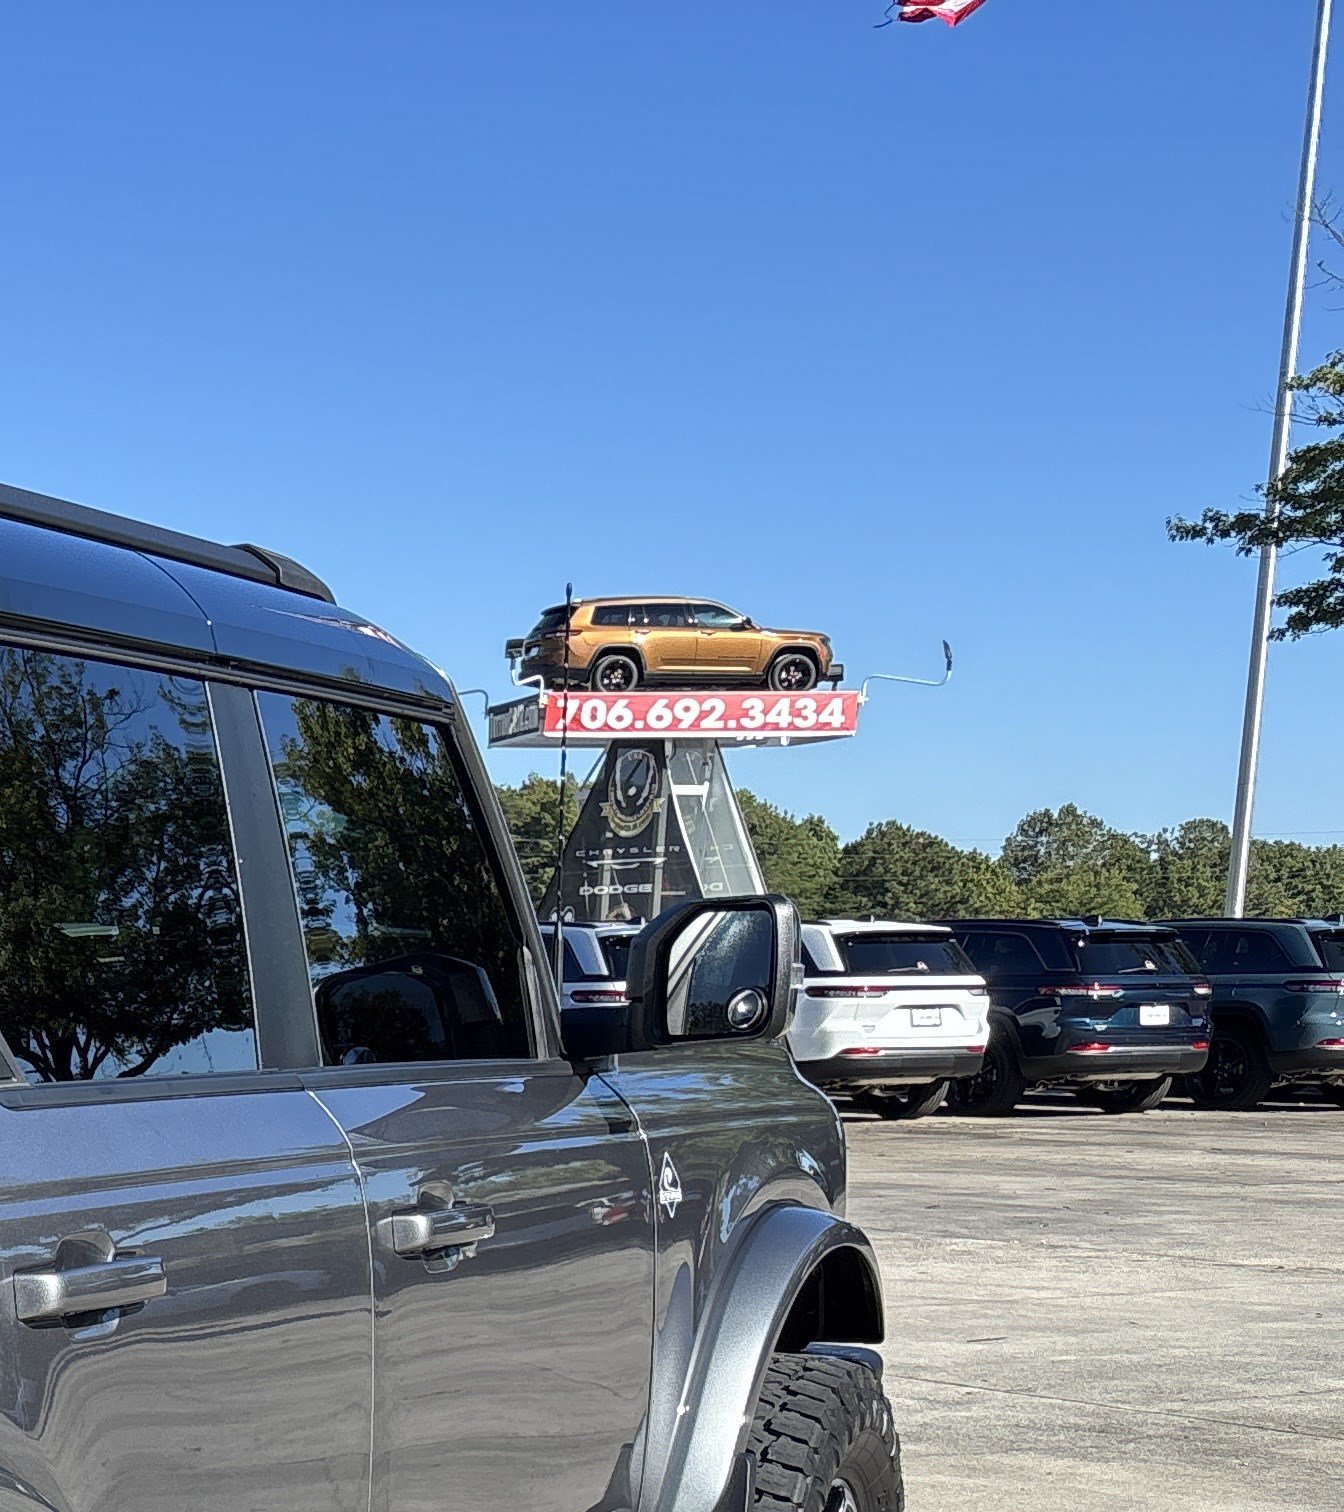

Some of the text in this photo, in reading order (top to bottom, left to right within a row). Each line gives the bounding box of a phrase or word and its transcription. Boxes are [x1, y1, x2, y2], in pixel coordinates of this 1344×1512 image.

[555, 698, 846, 730] 706.692.3434
[574, 844, 681, 858] CHRYSLER
[578, 883, 653, 896] DODGE
